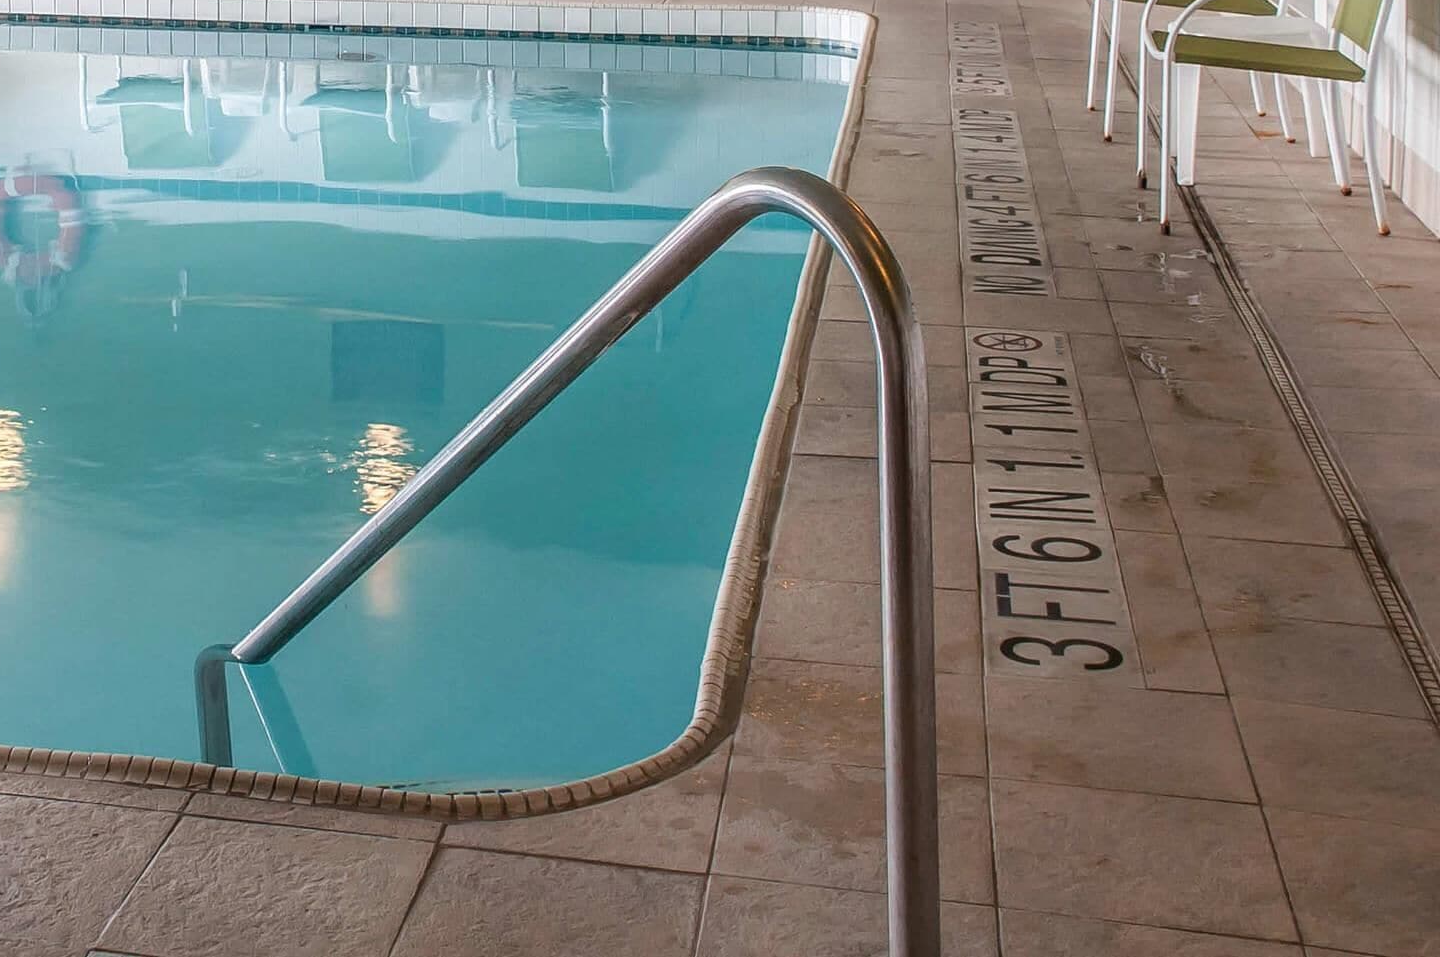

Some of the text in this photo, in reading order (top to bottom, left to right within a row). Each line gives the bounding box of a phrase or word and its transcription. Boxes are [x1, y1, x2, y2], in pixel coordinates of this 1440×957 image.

[959, 108, 1013, 122] DP
[964, 173, 1025, 184] 6
[964, 184, 1030, 204] FT
[967, 205, 1030, 216] 4
[972, 275, 1049, 297] NO
[978, 355, 1068, 387] DP
[981, 390, 1074, 415] M
[987, 487, 1097, 524] IN
[992, 534, 1102, 563] 6
[994, 572, 1117, 625] FT
[999, 636, 1124, 670] 3
